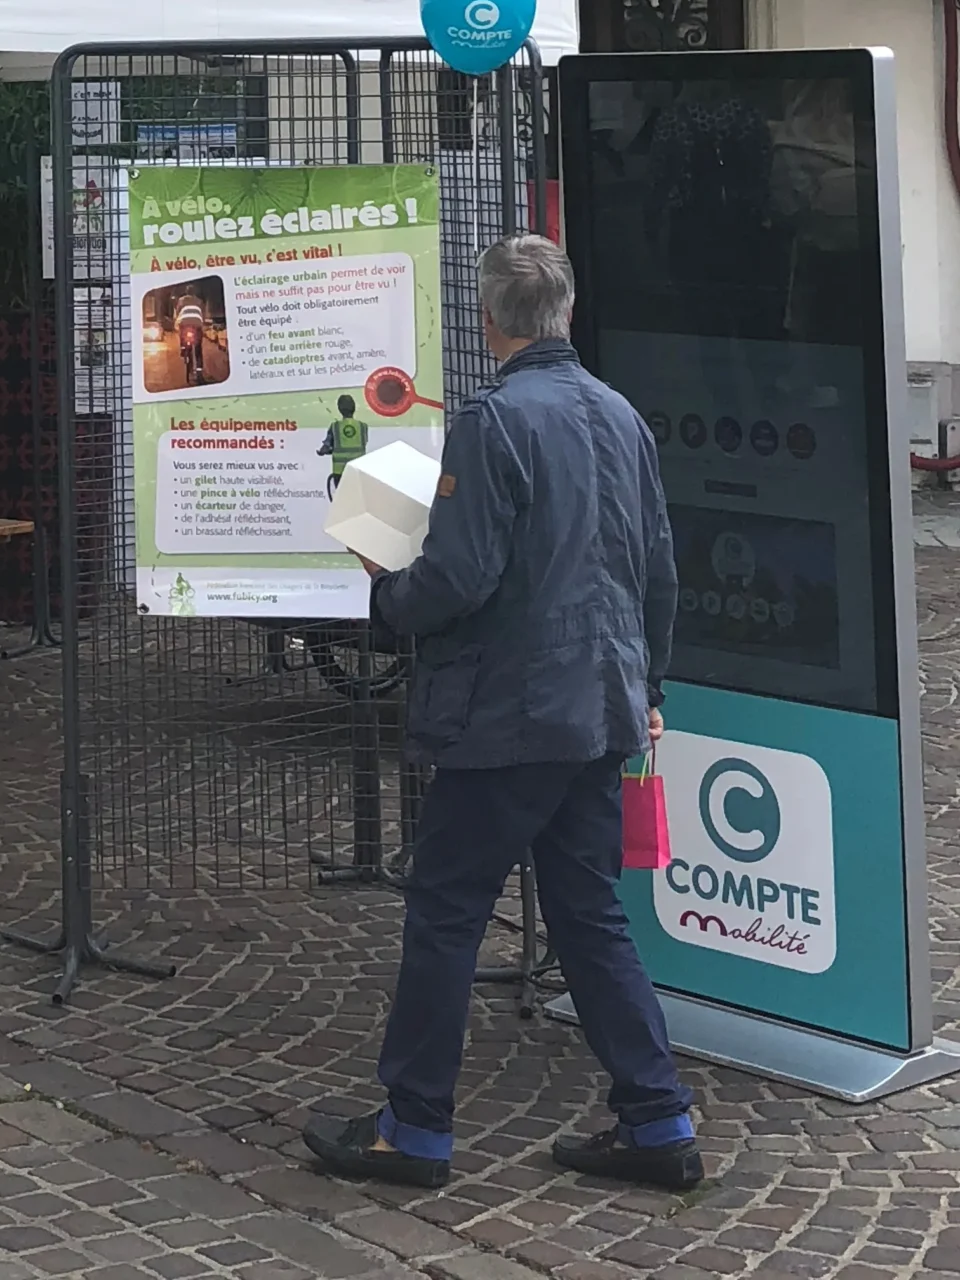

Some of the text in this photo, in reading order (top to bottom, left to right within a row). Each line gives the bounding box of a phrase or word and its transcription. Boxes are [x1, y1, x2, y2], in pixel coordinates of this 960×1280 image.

[447, 26, 513, 41] COMPTE
[141, 194, 231, 219] À vélo,
[142, 197, 418, 245] roulez éclairés !
[150, 243, 343, 273] À vélo, être vu, c'est vital !
[234, 264, 406, 287] L'éclairage urbain permet de voir
[235, 290, 260, 301] mais
[262, 289, 276, 298] ne
[278, 284, 304, 297] suffit
[306, 285, 325, 298] pas
[328, 283, 352, 296] pour
[355, 279, 375, 291] être
[377, 280, 390, 290] vu
[236, 295, 379, 315] Tout vélo doit obligatoirement
[238, 318, 257, 328] être
[259, 315, 293, 328] équipé
[246, 331, 266, 342] d'un
[268, 329, 286, 340] feu
[287, 328, 316, 339] avant
[247, 344, 267, 354] d'un
[270, 342, 286, 352] feu
[289, 340, 322, 351] arrière
[248, 356, 261, 367] de
[262, 353, 325, 366] catadioptres
[249, 369, 285, 380] latéraux
[287, 368, 296, 377] et
[298, 368, 312, 377] sur
[314, 365, 327, 375] les
[170, 417, 298, 432] Les équipements
[170, 436, 275, 449] recommandés
[173, 461, 196, 470] Vous
[198, 462, 224, 470] serez
[226, 460, 256, 470] mieux
[257, 462, 275, 470] vus
[276, 462, 299, 470] avec
[194, 475, 218, 487] gilet
[219, 476, 246, 485] haute
[200, 488, 228, 501] pince
[230, 487, 237, 497] à
[239, 487, 261, 498] vélo
[195, 500, 237, 510] écarteur
[239, 501, 251, 510] de
[180, 514, 193, 523] de
[181, 528, 193, 536] un
[195, 526, 233, 536] brassard
[206, 592, 278, 603] www.fubicy.org
[665, 857, 822, 926] COMPTE
